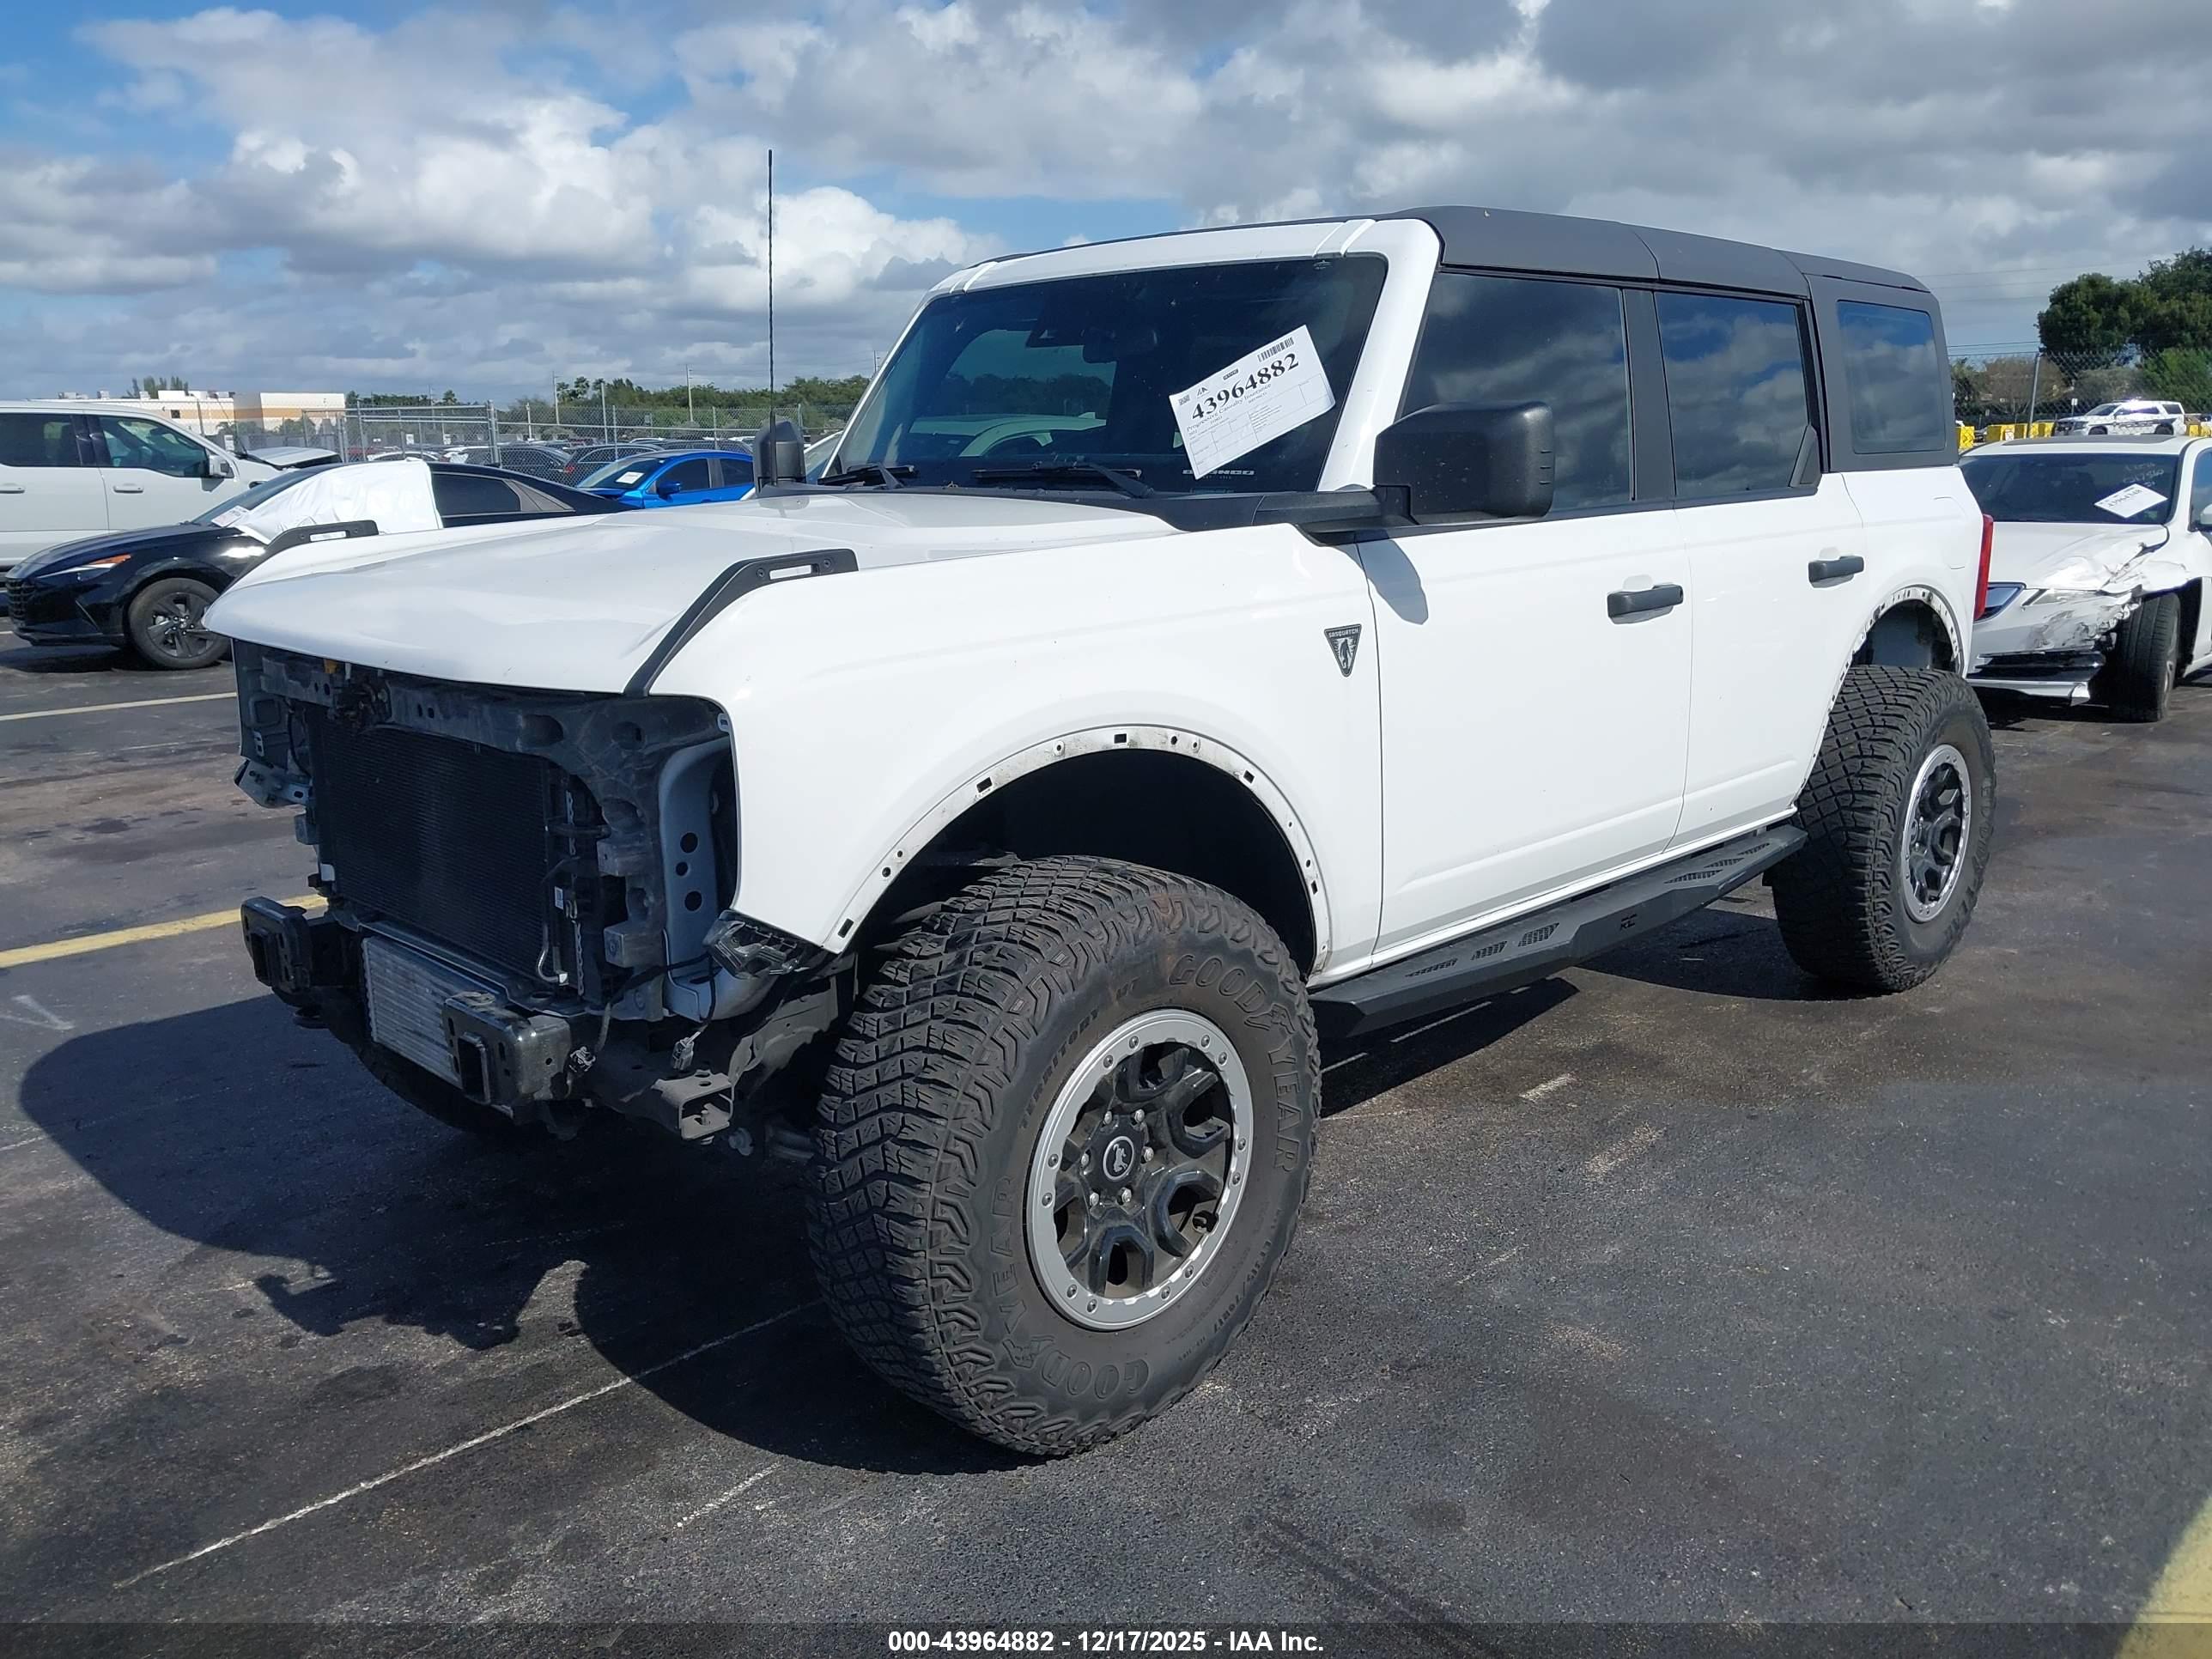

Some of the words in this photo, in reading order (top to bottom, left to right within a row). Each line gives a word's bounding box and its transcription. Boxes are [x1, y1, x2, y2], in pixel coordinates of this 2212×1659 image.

[1192, 353, 1299, 419] 43964882
[1219, 398, 1244, 415] Casualty
[1328, 628, 1358, 638] SASQUATCH
